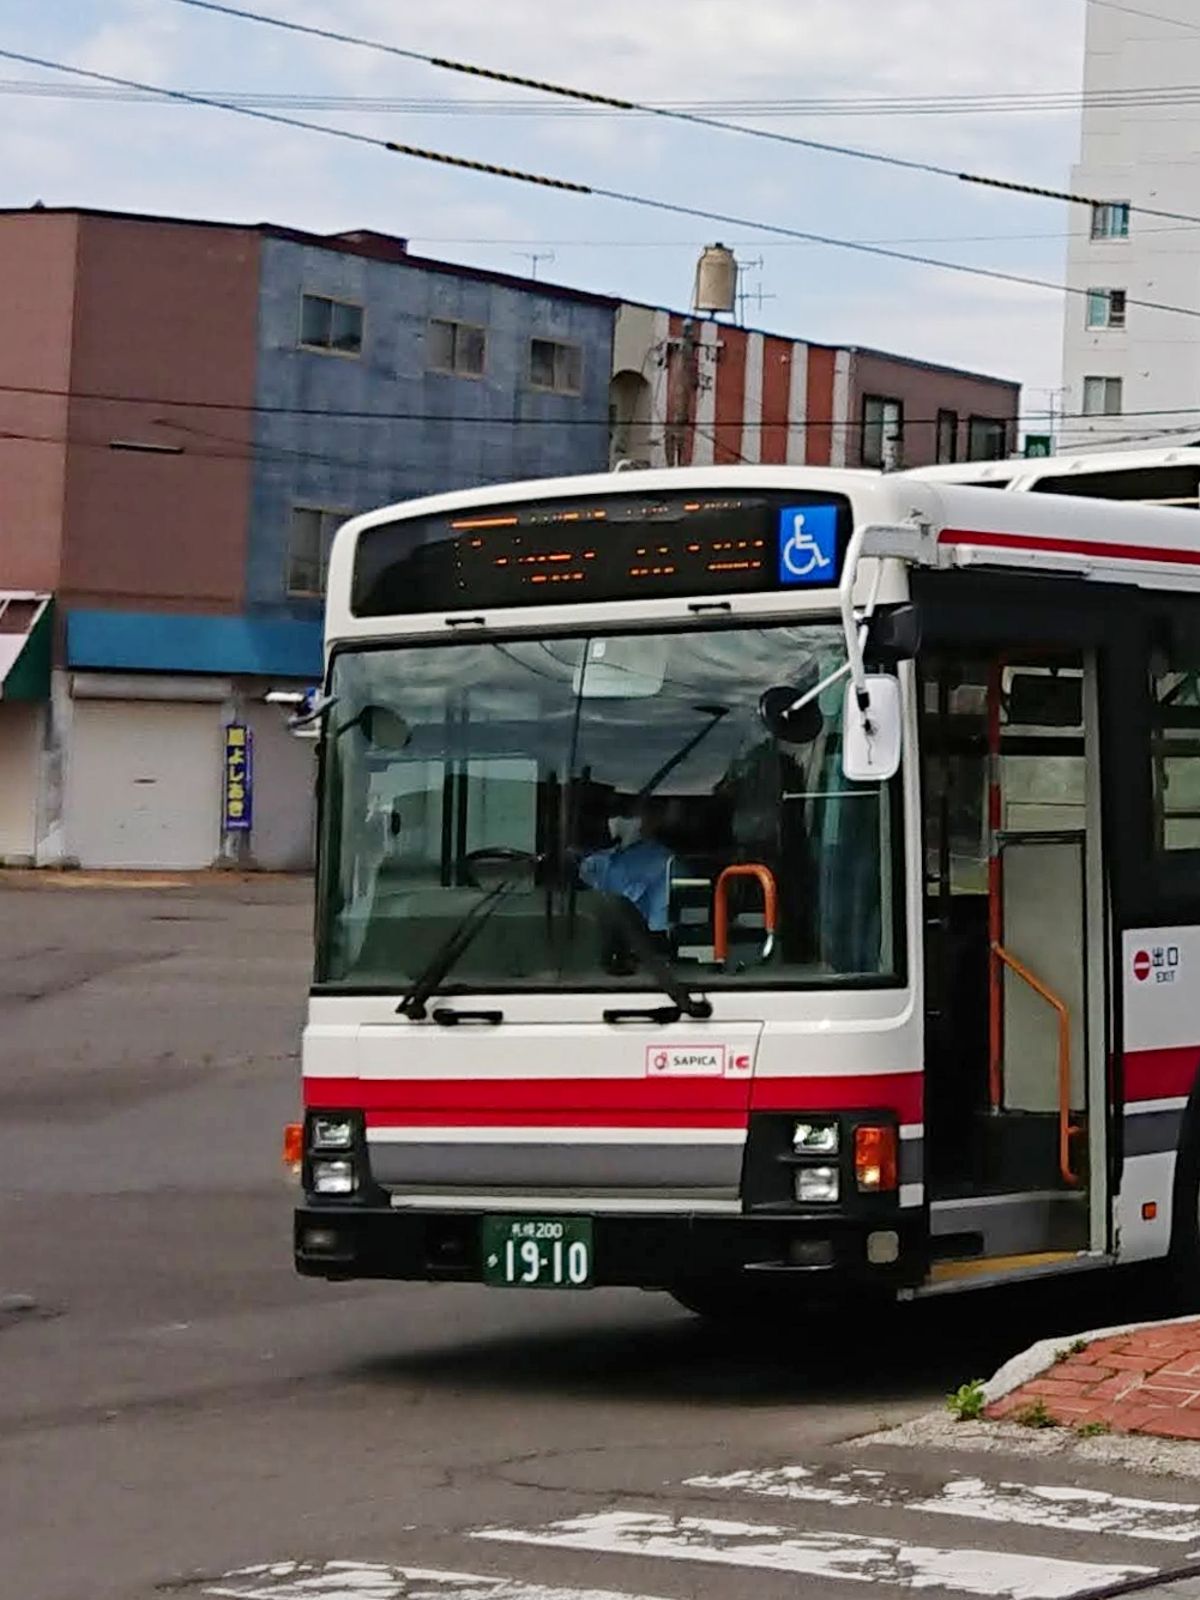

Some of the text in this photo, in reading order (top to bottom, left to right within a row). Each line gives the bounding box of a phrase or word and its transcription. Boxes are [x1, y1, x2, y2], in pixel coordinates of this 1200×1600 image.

[1151, 946, 1178, 967] 出口
[1155, 970, 1176, 983] EXIT
[673, 1055, 717, 1066] SAPICA
[505, 1239, 588, 1284] 19-10
